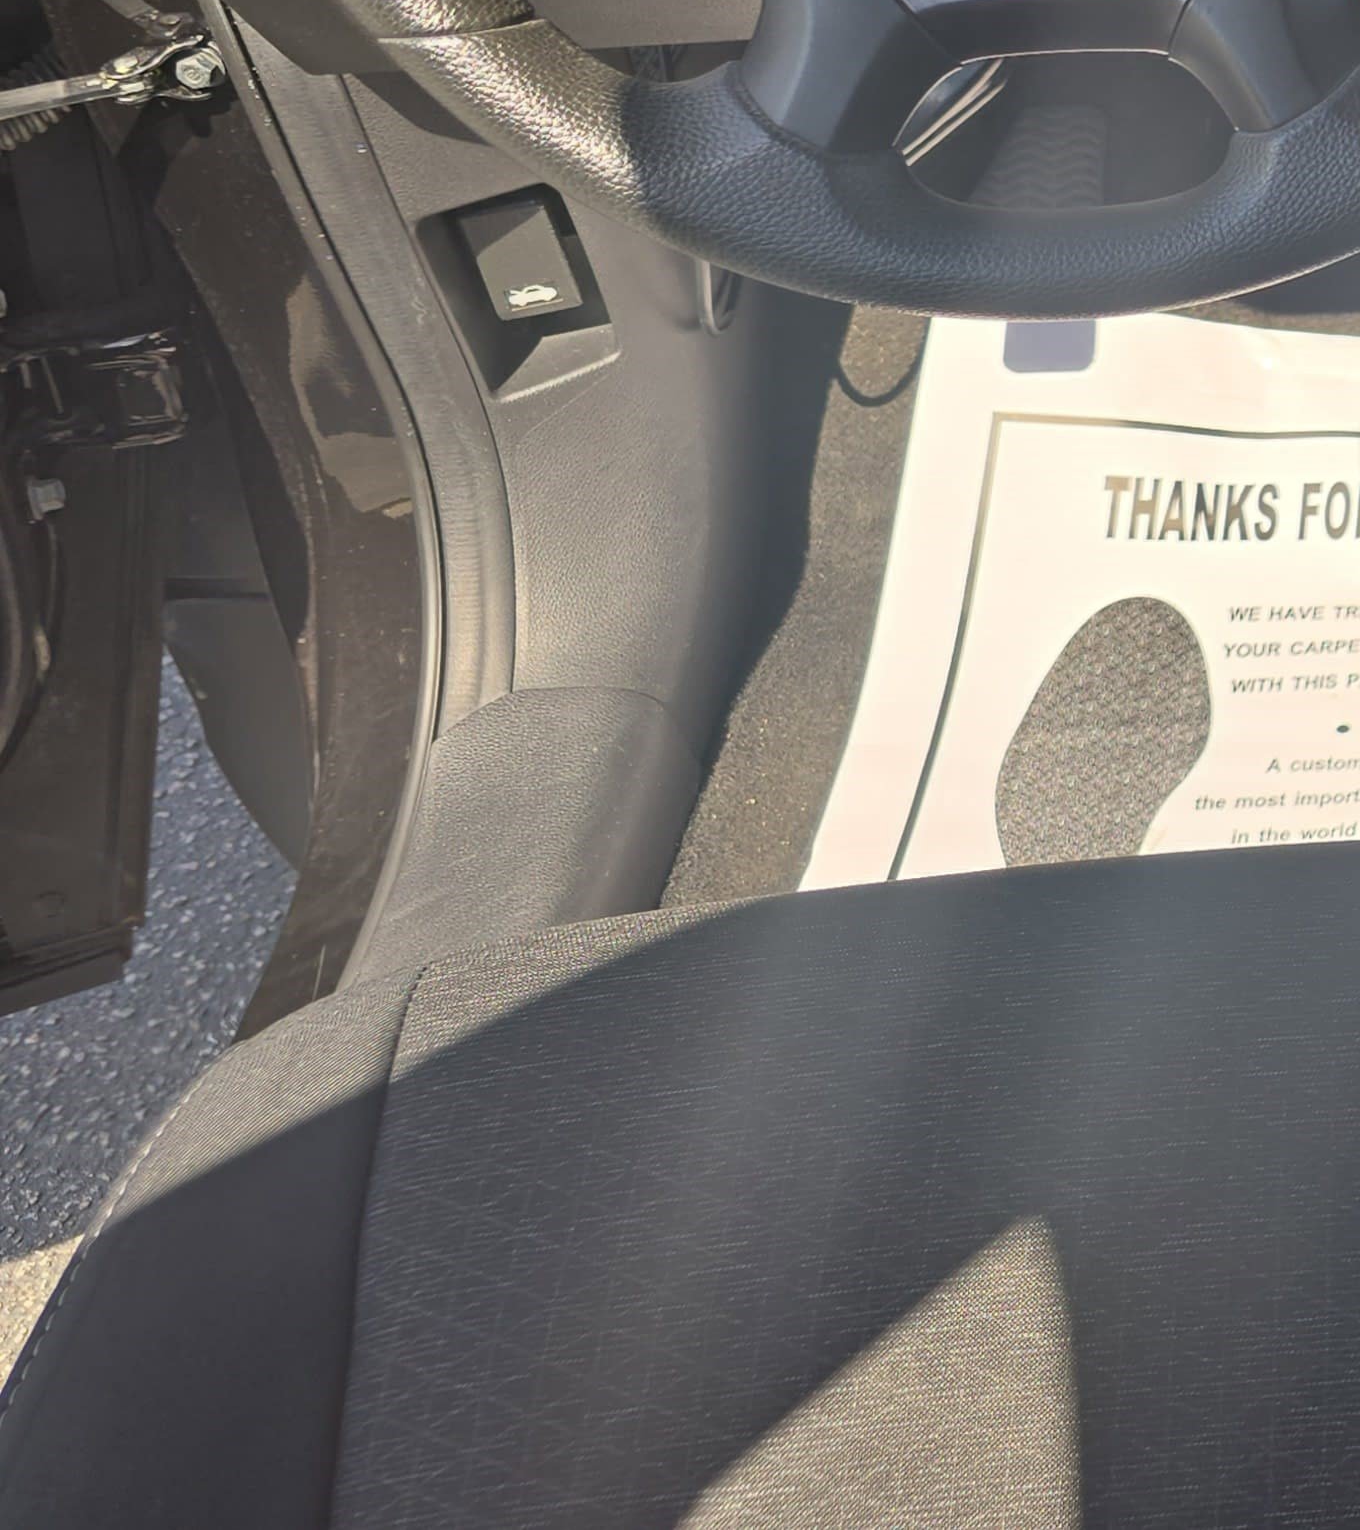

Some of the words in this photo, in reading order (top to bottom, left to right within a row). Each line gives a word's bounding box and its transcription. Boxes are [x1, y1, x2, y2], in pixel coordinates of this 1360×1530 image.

[1104, 474, 1280, 542] THANKS
[1229, 605, 1262, 622] WE
[1268, 605, 1325, 621] HAVE
[1223, 641, 1281, 658] YOUR
[1231, 676, 1283, 693] WITH
[1292, 673, 1338, 691] THIS
[1265, 757, 1281, 773] A
[1194, 795, 1227, 811] the
[1234, 792, 1286, 809] most
[1231, 828, 1250, 845] in
[1259, 826, 1291, 843] the
[1300, 821, 1357, 840] world
